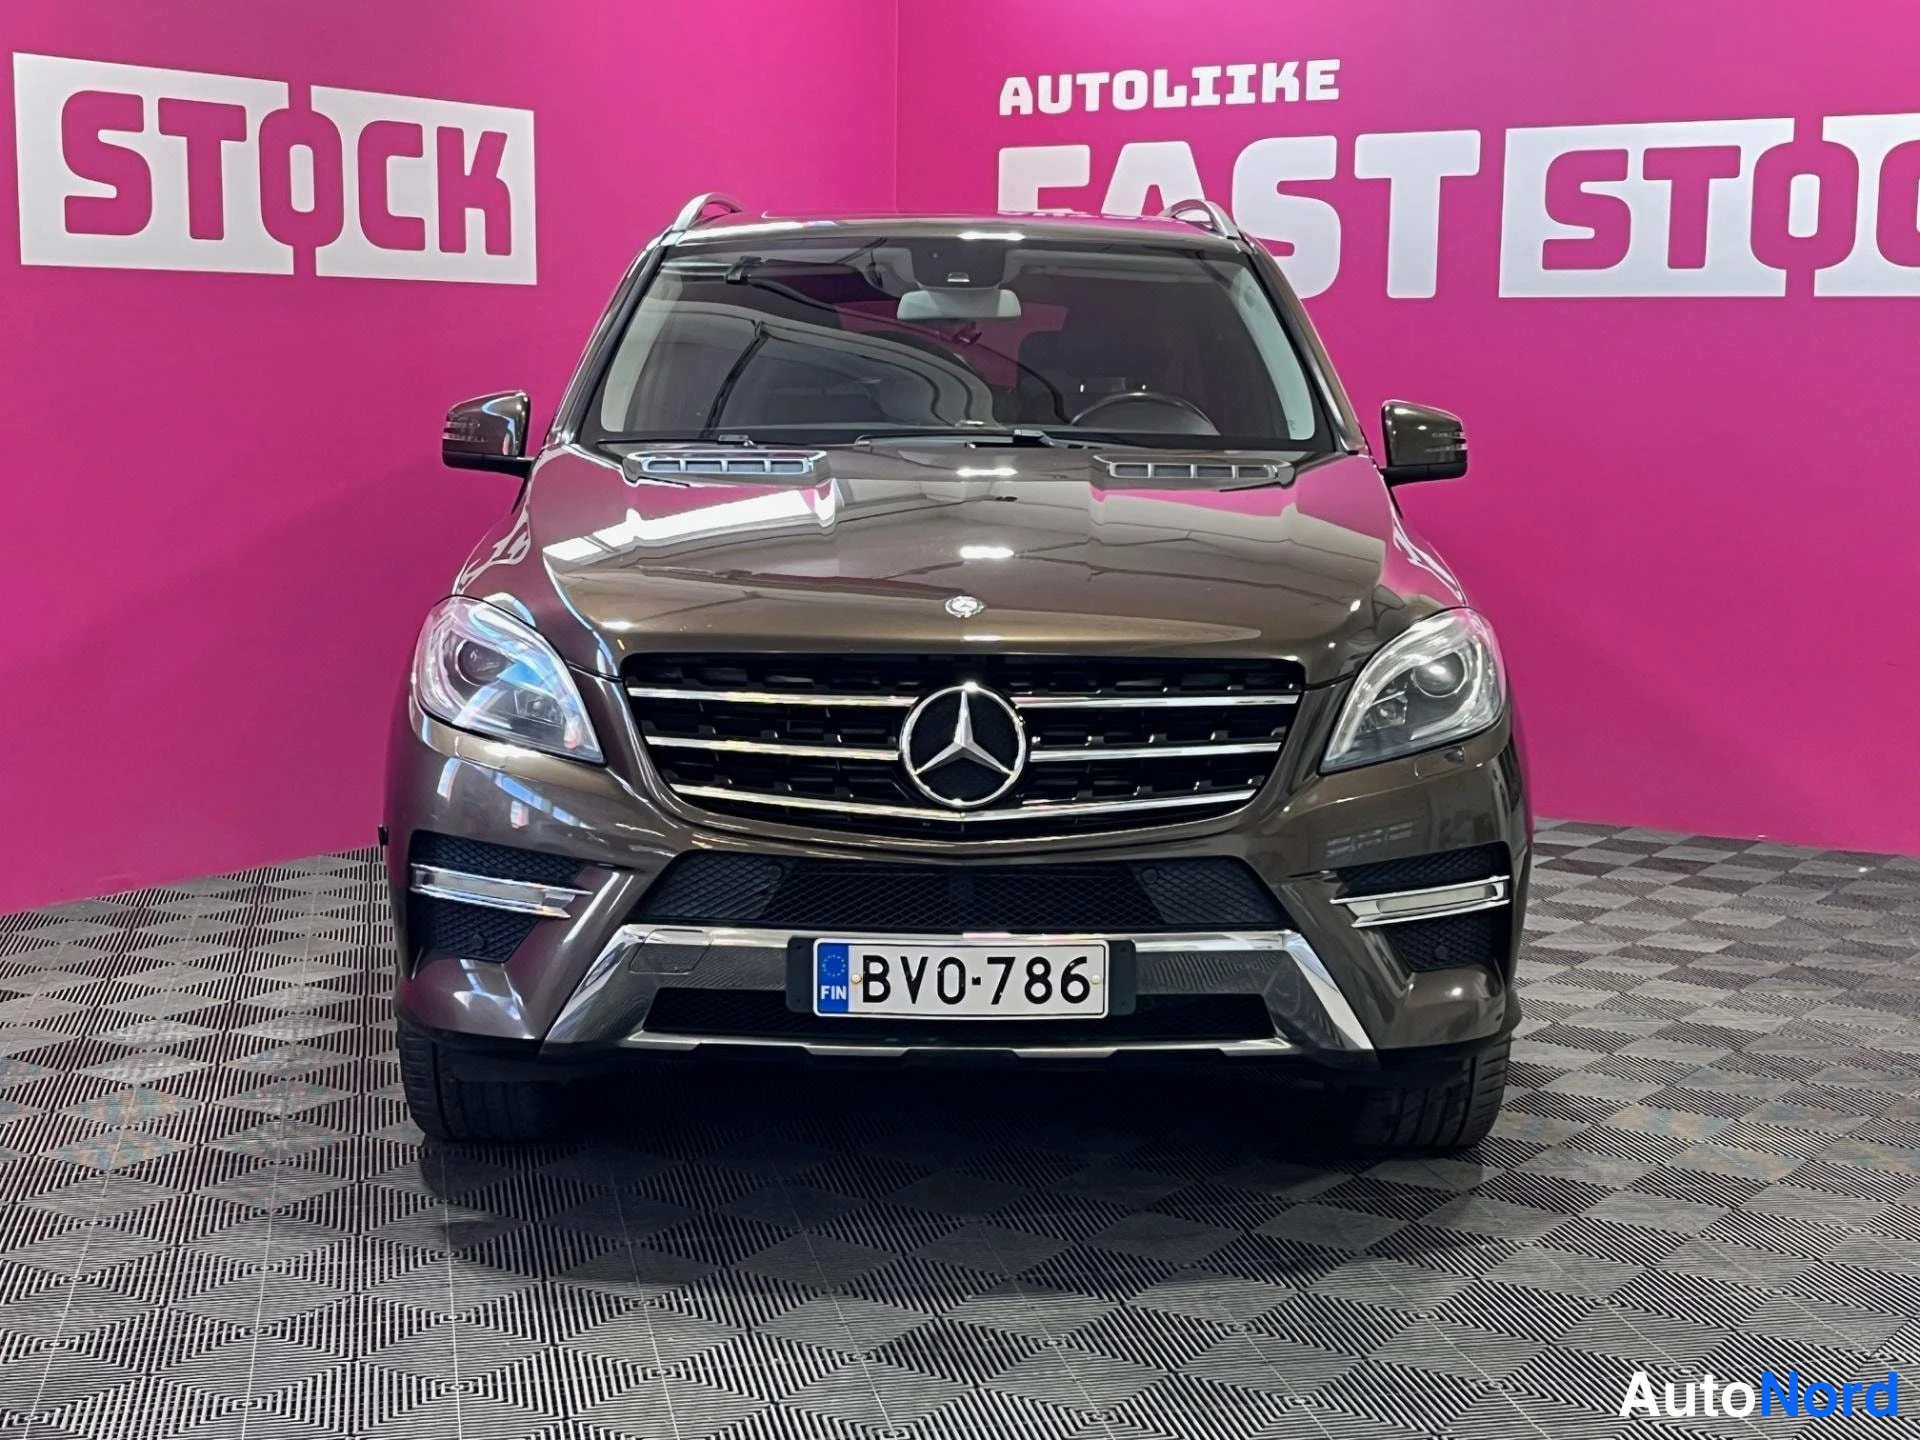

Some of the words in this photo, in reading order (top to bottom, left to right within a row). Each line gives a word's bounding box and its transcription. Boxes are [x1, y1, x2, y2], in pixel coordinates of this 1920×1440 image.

[999, 59, 1341, 116] AUTOLIIKE
[60, 89, 513, 257] STOCK
[820, 985, 847, 1001] FIN
[862, 954, 1091, 1006] BVO-786
